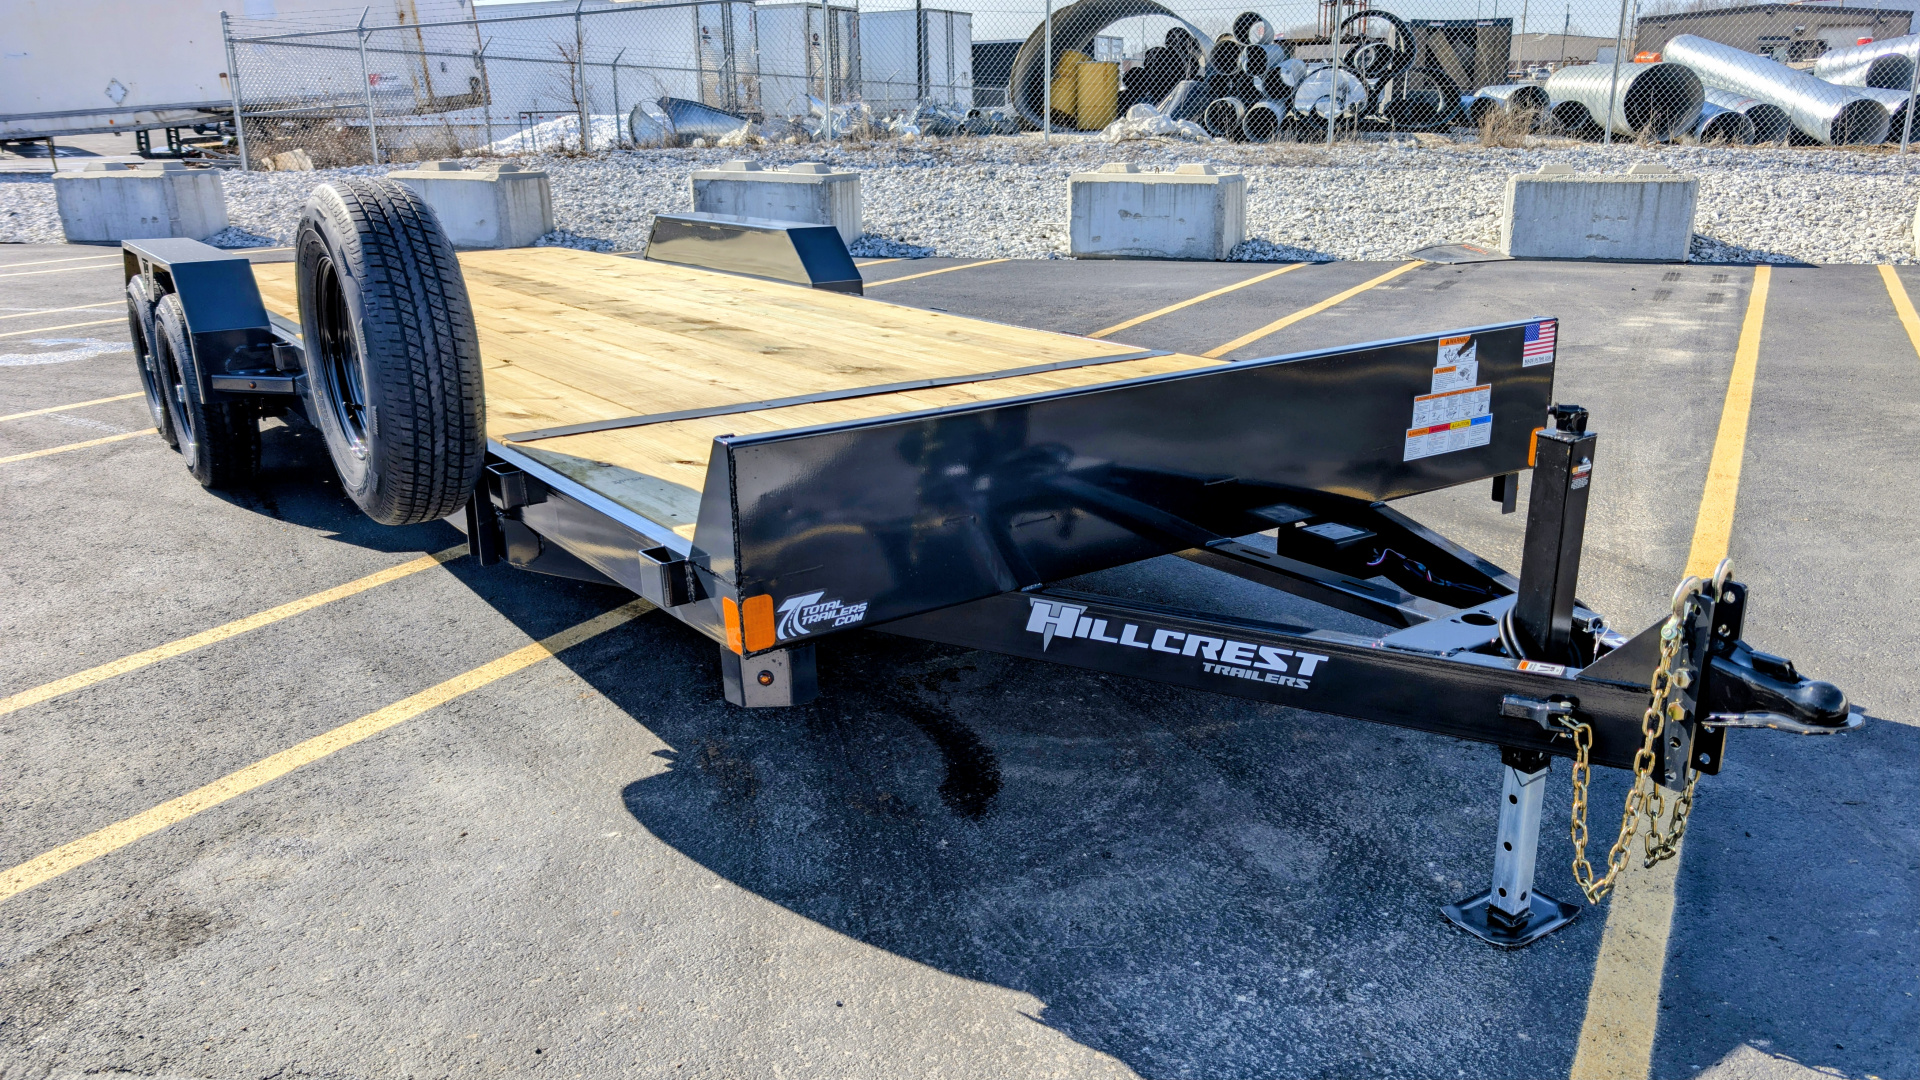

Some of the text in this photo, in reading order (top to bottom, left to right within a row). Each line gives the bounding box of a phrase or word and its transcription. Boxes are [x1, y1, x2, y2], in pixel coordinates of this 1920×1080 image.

[1412, 428, 1428, 436] WARNING
[802, 602, 868, 625] TRAILERS
[803, 600, 844, 616] TOTAL
[832, 612, 864, 627] .COM
[1026, 597, 1329, 677] HILLCREST
[1203, 662, 1311, 690] TRAILERS
